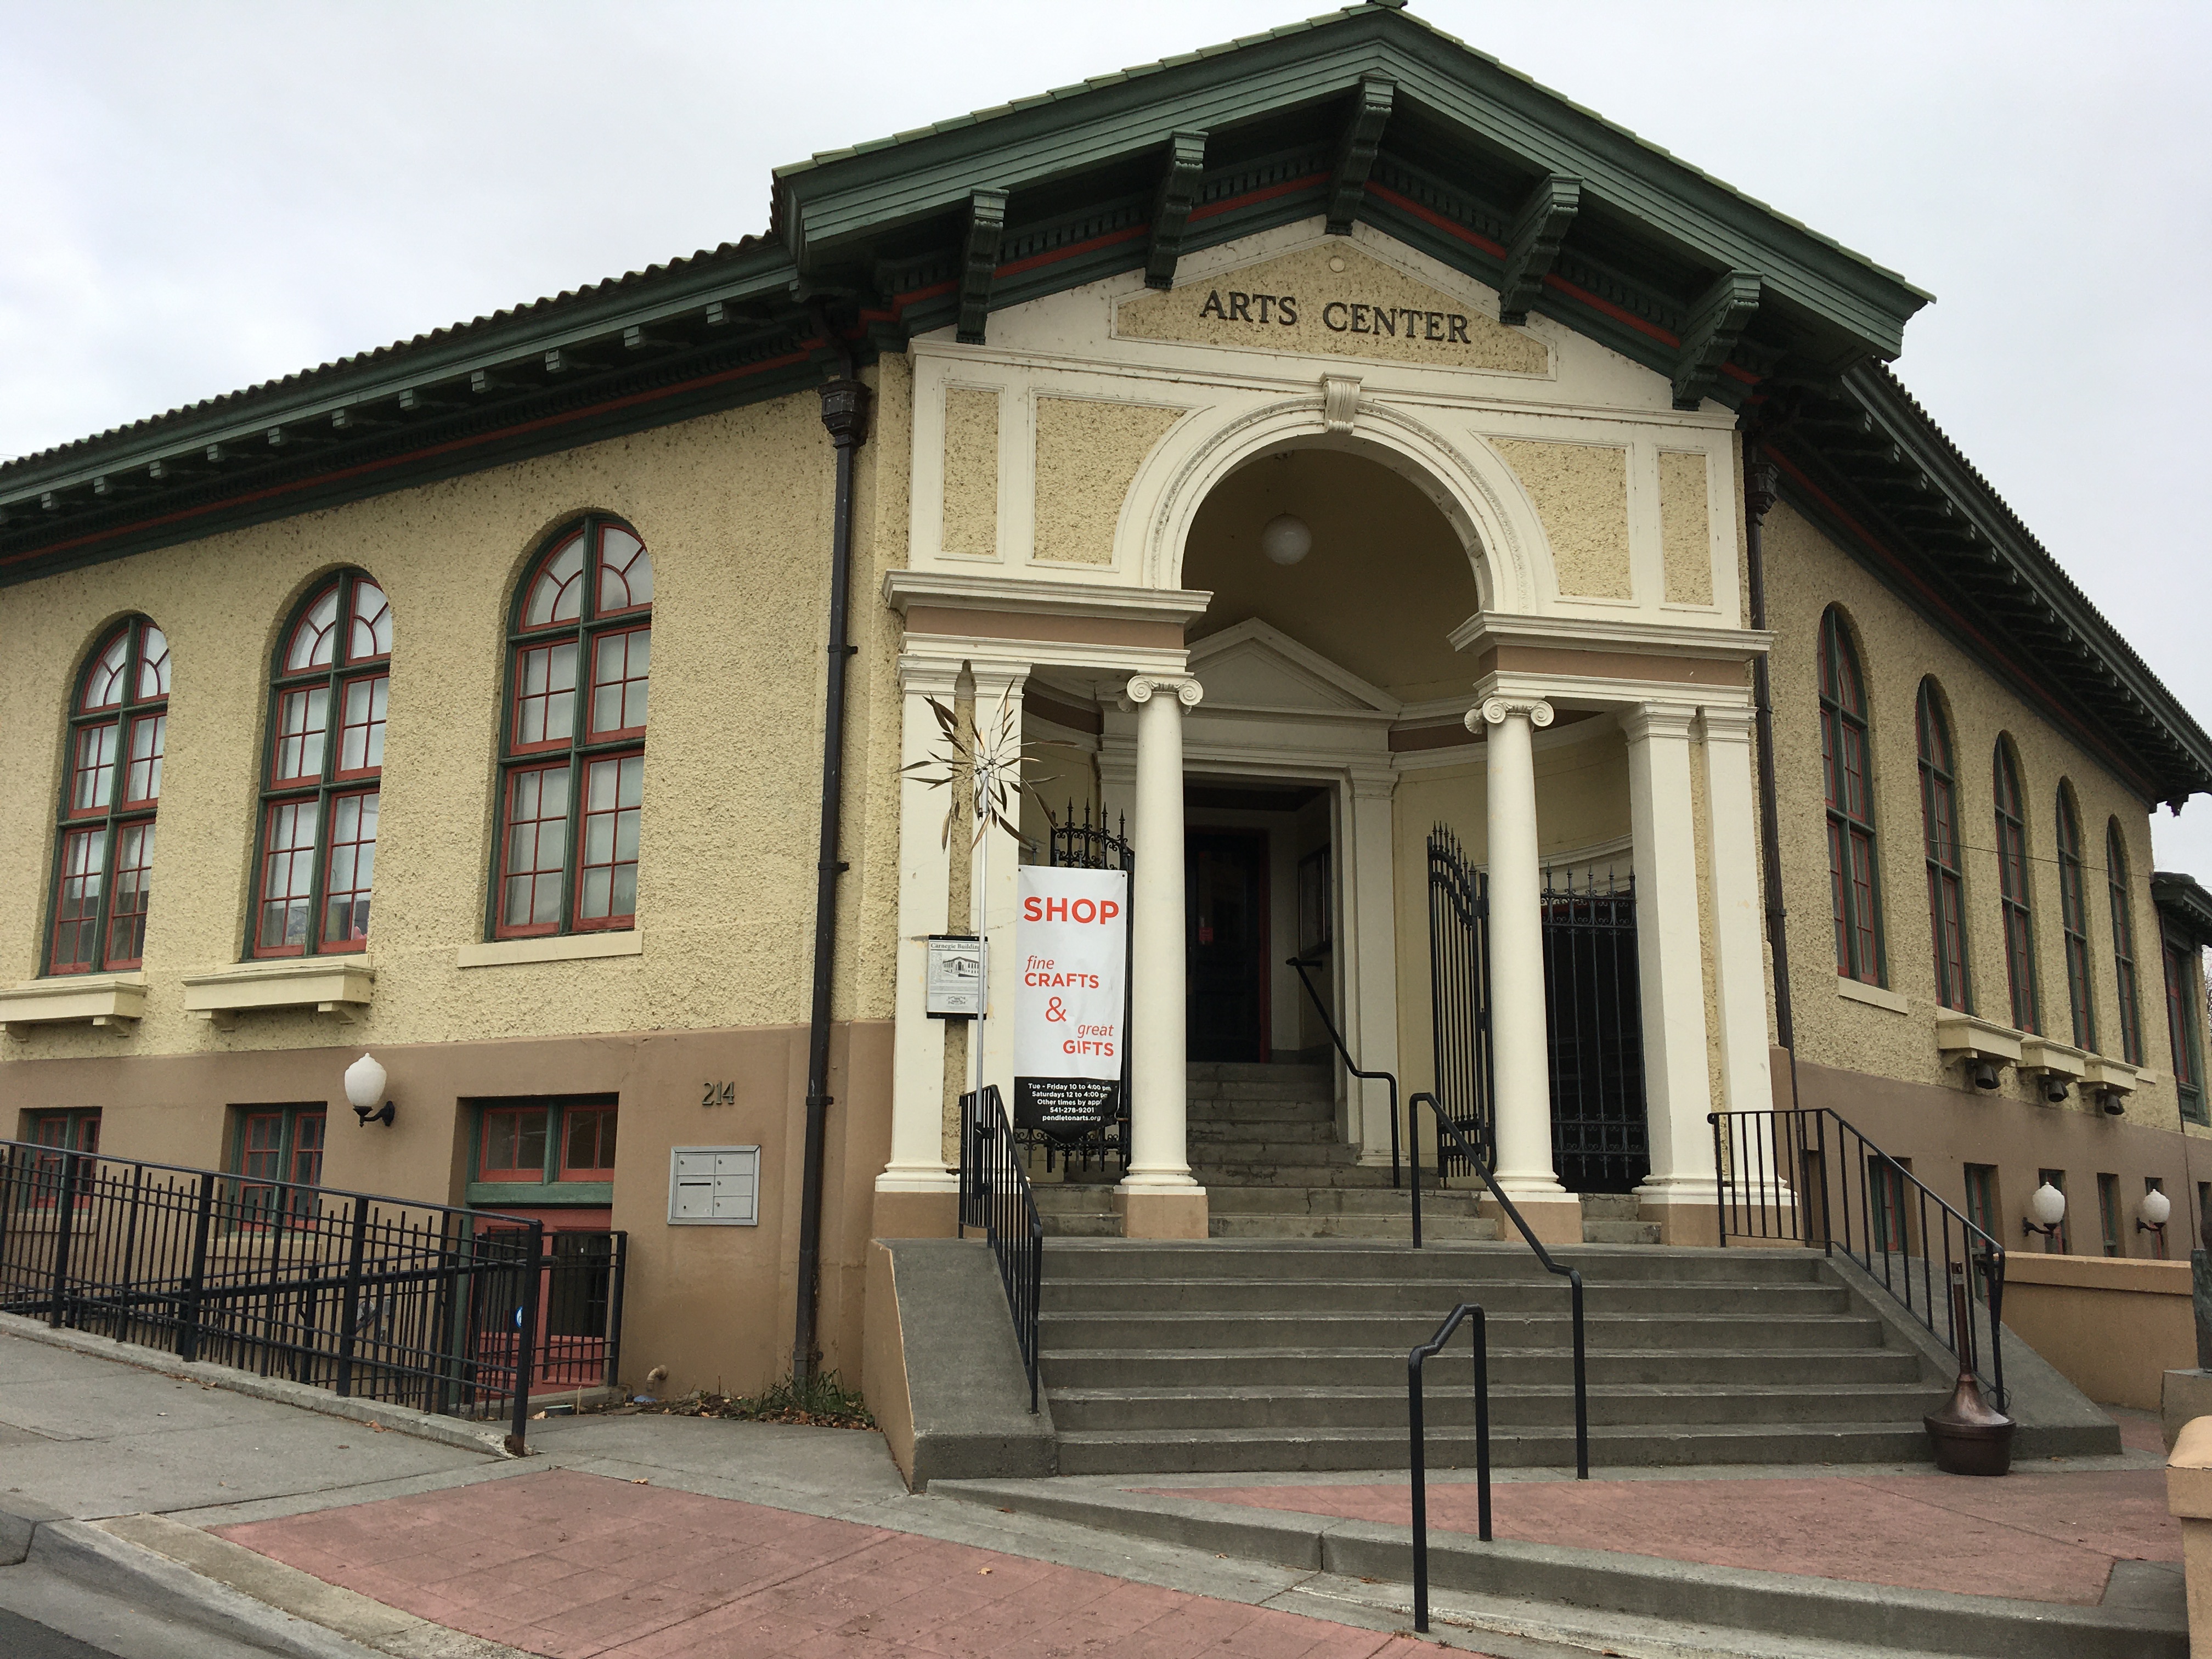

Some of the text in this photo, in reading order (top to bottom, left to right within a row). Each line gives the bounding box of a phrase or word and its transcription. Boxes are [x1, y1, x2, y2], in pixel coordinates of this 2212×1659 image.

[1199, 290, 1471, 344] ARTS CENTER
[1023, 896, 1119, 925] SHOP
[1025, 955, 1054, 973] fine
[1024, 973, 1099, 989] CRAFTS
[1045, 996, 1066, 1022] &
[1077, 1024, 1114, 1038] great
[1063, 1040, 1114, 1057] GIFTS
[702, 1081, 735, 1105] 214
